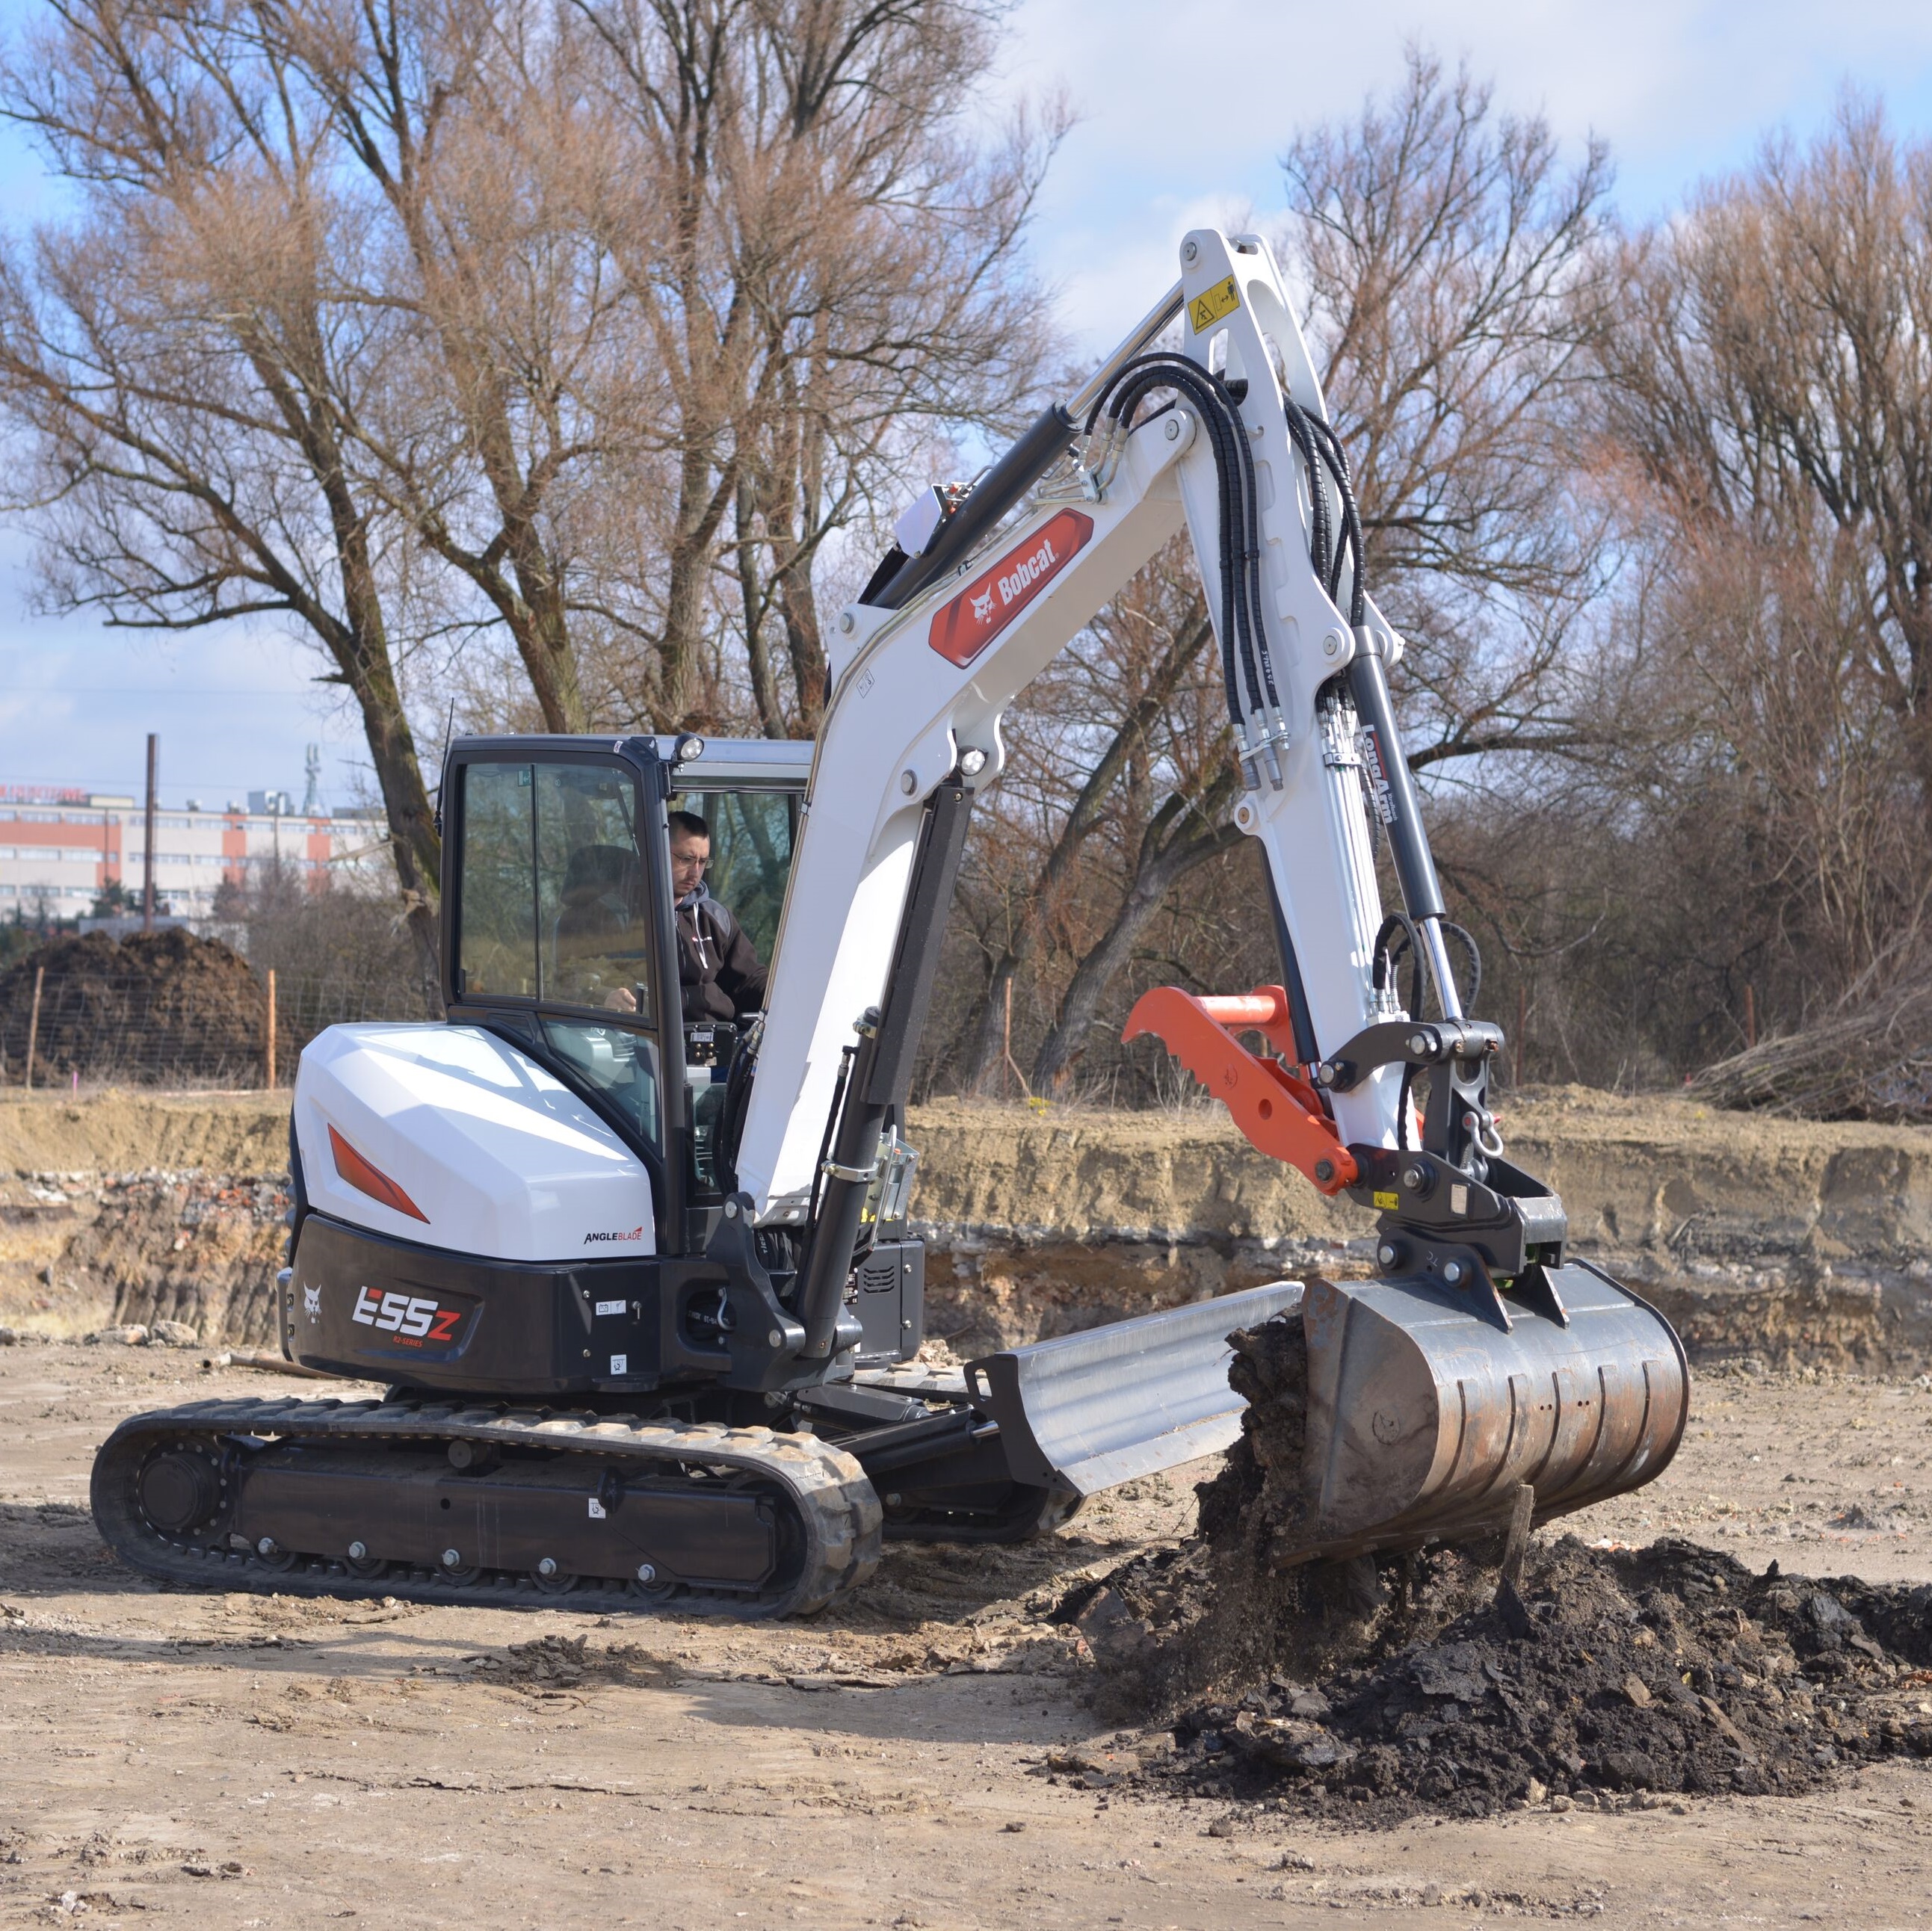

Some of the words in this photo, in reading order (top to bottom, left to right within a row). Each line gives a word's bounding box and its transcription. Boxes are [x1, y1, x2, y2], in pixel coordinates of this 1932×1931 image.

[997, 538, 1056, 606] Bobcat
[584, 1232, 642, 1245] ANGLEBLADE
[392, 1335, 424, 1348] R2-SERIES
